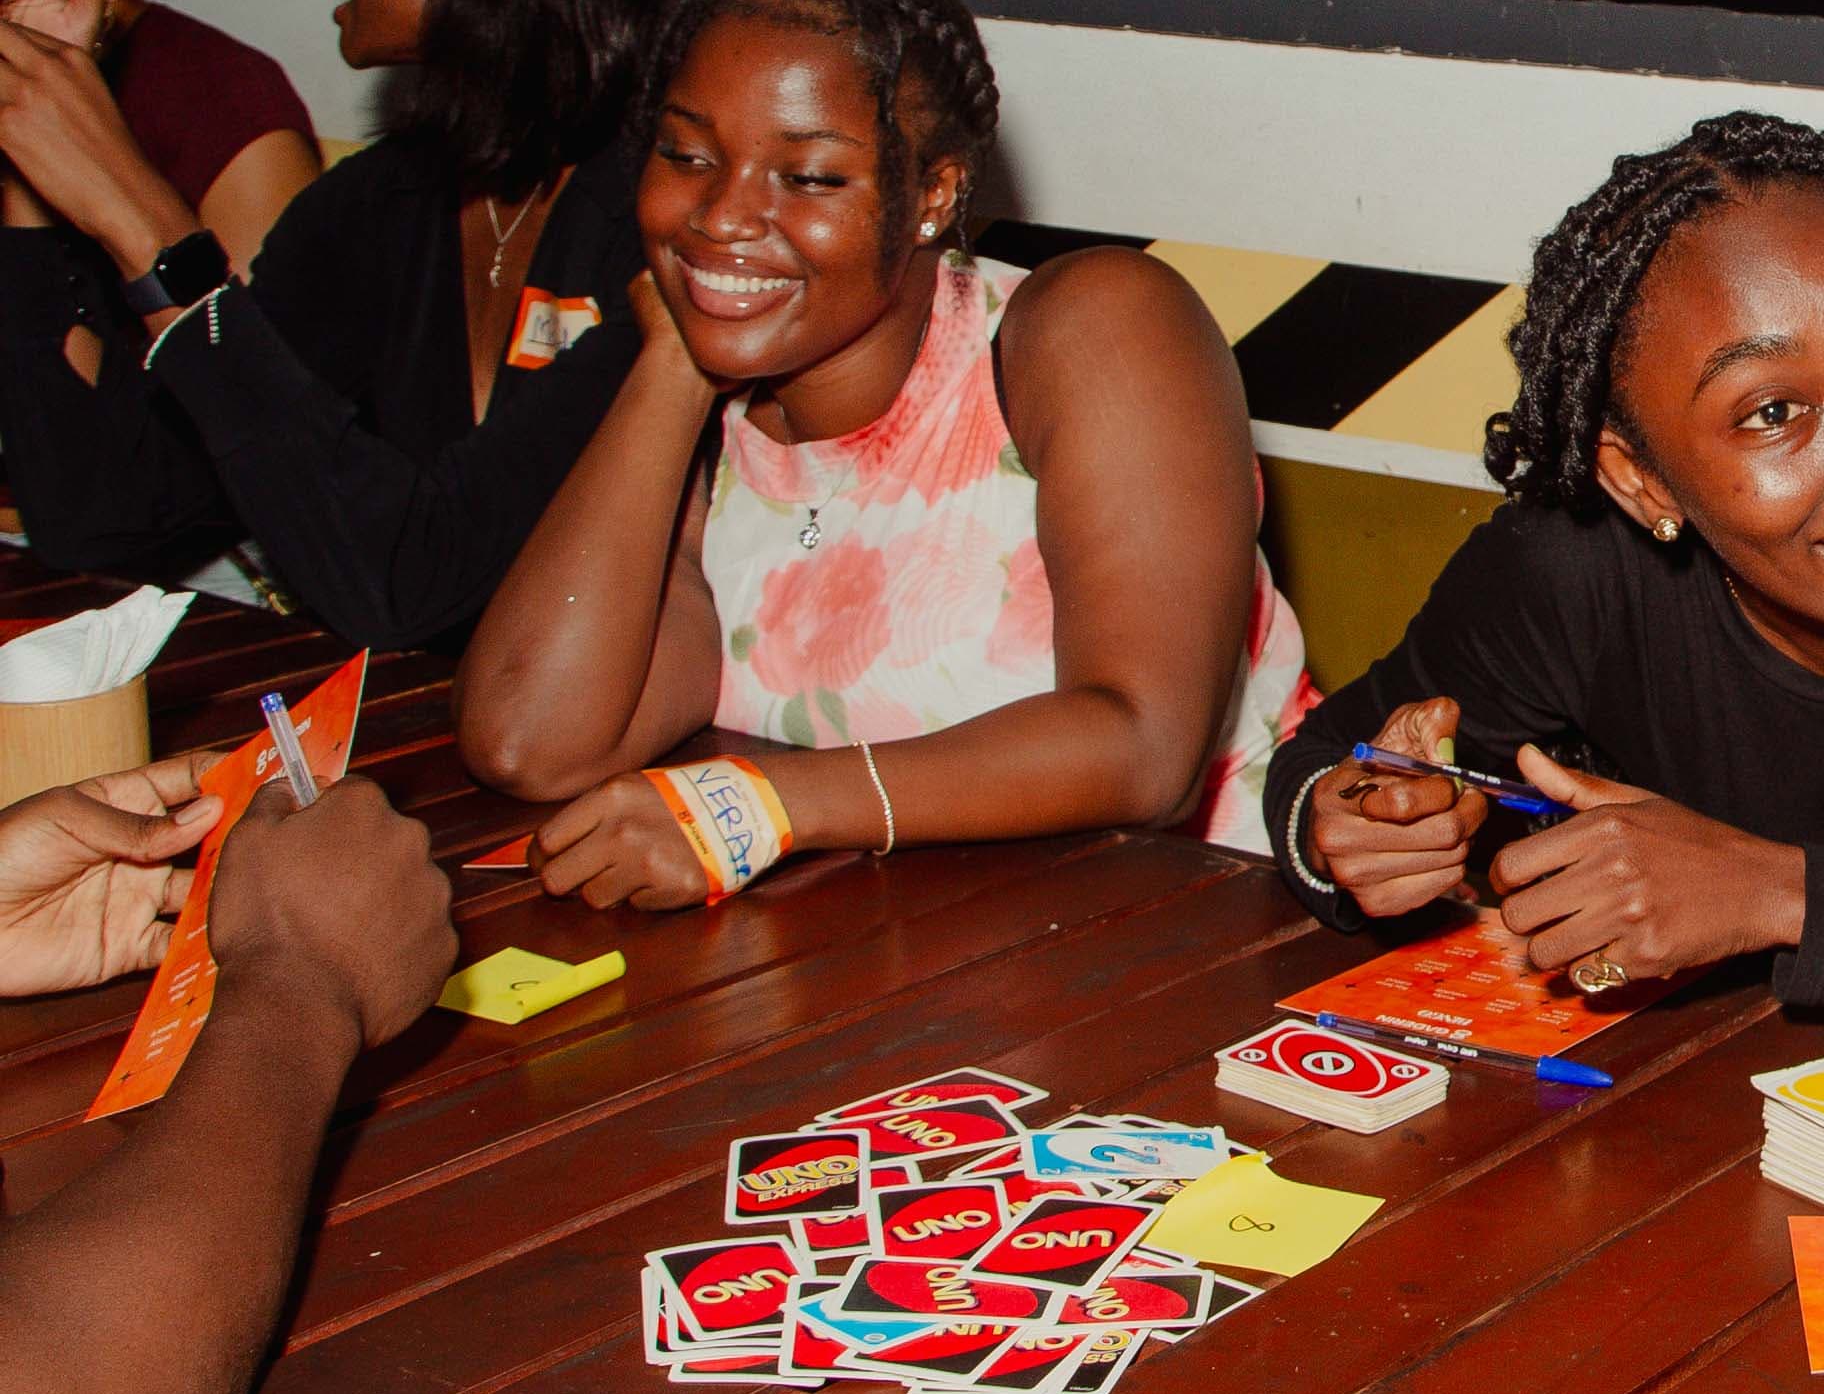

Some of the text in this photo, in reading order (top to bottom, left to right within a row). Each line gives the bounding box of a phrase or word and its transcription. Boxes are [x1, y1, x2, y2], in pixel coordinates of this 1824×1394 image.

[879, 1114, 957, 1148] UNO
[738, 1154, 860, 1194] UNO
[758, 1174, 856, 1204] EXPRESS
[892, 1209, 992, 1242] UNO
[1010, 1229, 1114, 1250] UNO
[693, 1268, 790, 1305] UNO
[926, 1266, 977, 1312] UNO
[1085, 1279, 1130, 1320] NO
